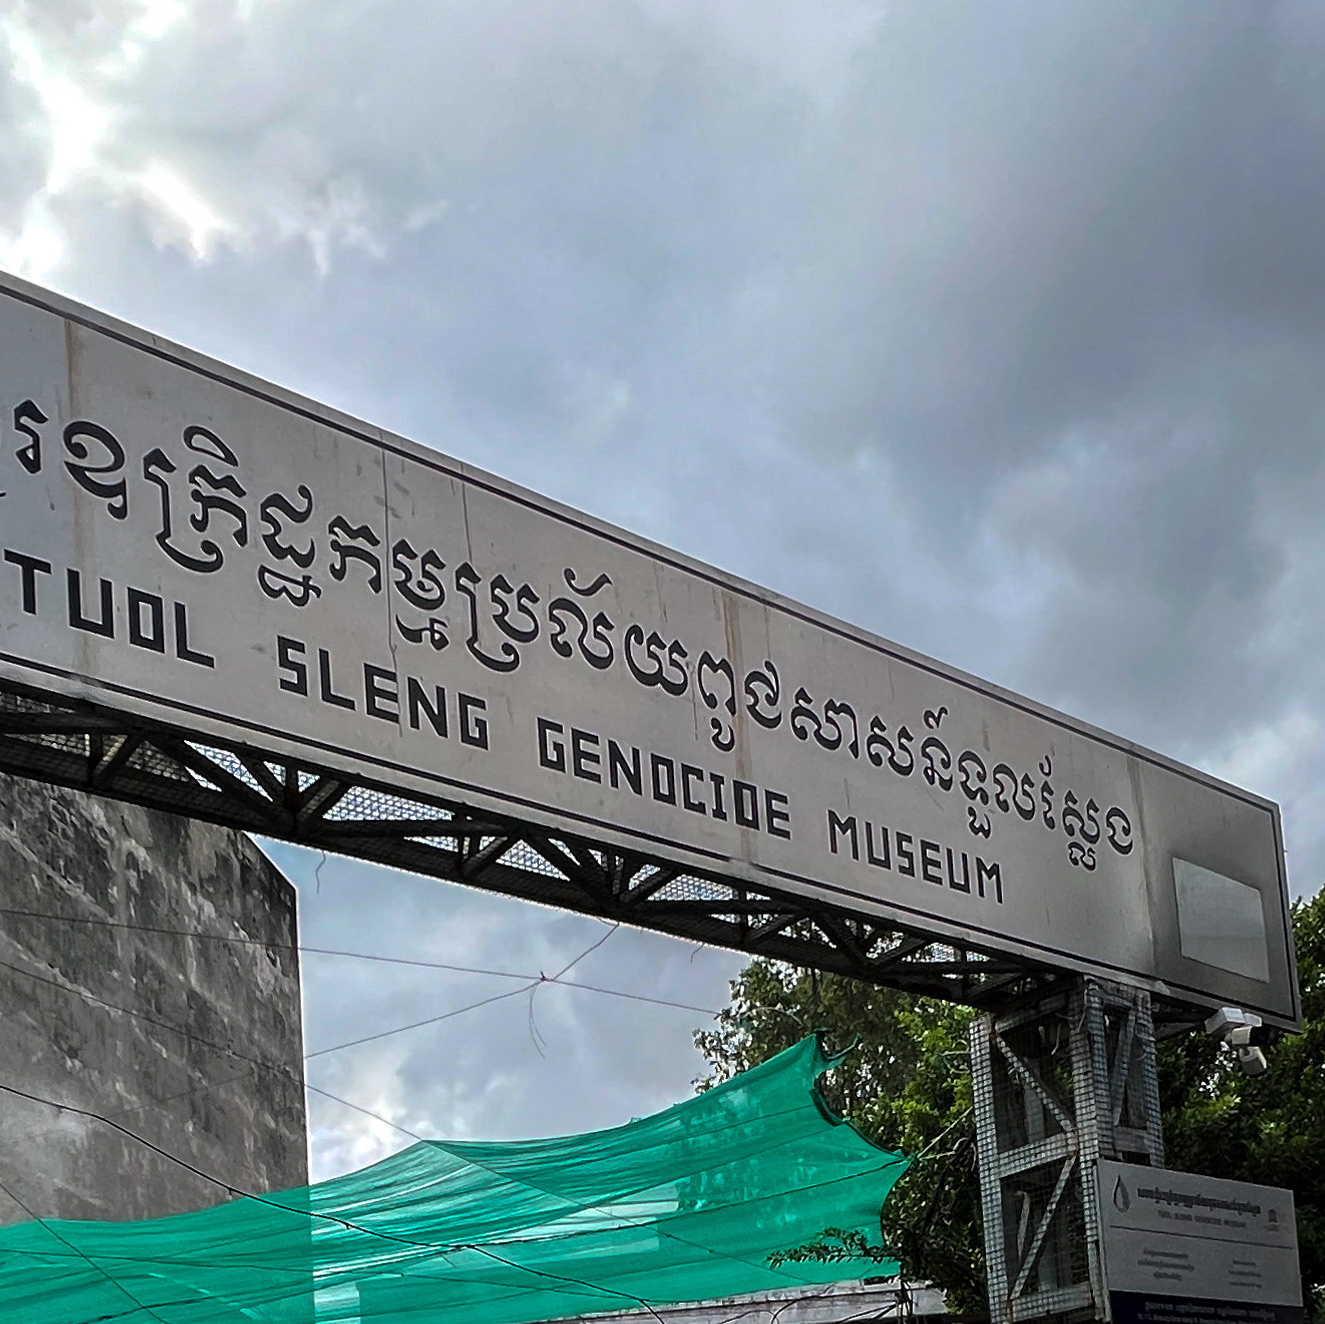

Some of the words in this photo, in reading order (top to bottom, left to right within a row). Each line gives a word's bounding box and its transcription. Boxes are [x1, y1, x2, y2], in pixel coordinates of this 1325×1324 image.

[3, 547, 215, 669] TUOL
[278, 634, 489, 752] SLENG
[537, 716, 792, 841] GENOCIDE
[827, 808, 1004, 905] MUSEUM
